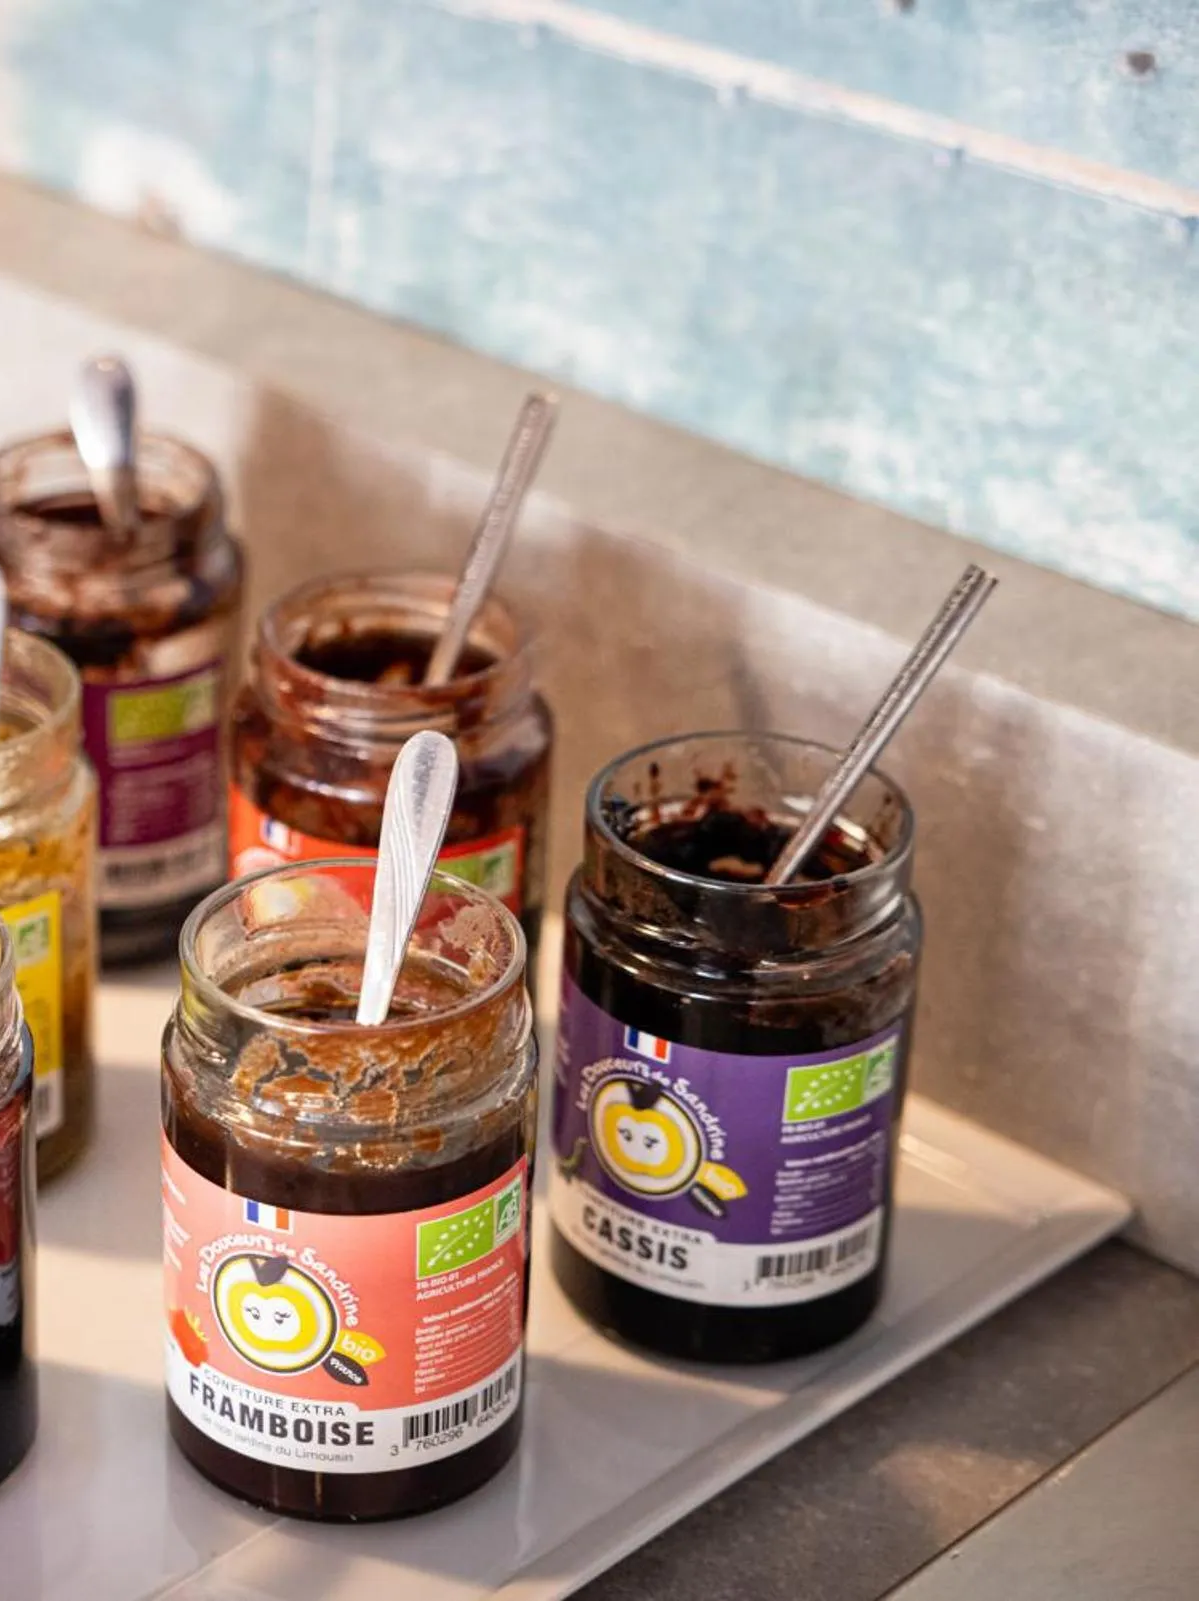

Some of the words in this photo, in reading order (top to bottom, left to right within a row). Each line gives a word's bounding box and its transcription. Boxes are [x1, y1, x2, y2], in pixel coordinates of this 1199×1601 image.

[673, 1078, 727, 1160] Sandrine
[199, 1234, 274, 1262] Douceurs
[582, 1204, 688, 1270] CASSIS
[196, 1262, 211, 1293] Les
[300, 1248, 359, 1328] Sandrine
[341, 1335, 376, 1361] bio
[189, 1372, 375, 1446] FRAMBOISE
[204, 1368, 284, 1409] CONFITURE
[291, 1402, 346, 1416] EXTRA
[276, 1445, 291, 1457] du
[295, 1448, 354, 1463] Limousin
[390, 1444, 400, 1457] 3
[415, 1426, 464, 1451] 760296
